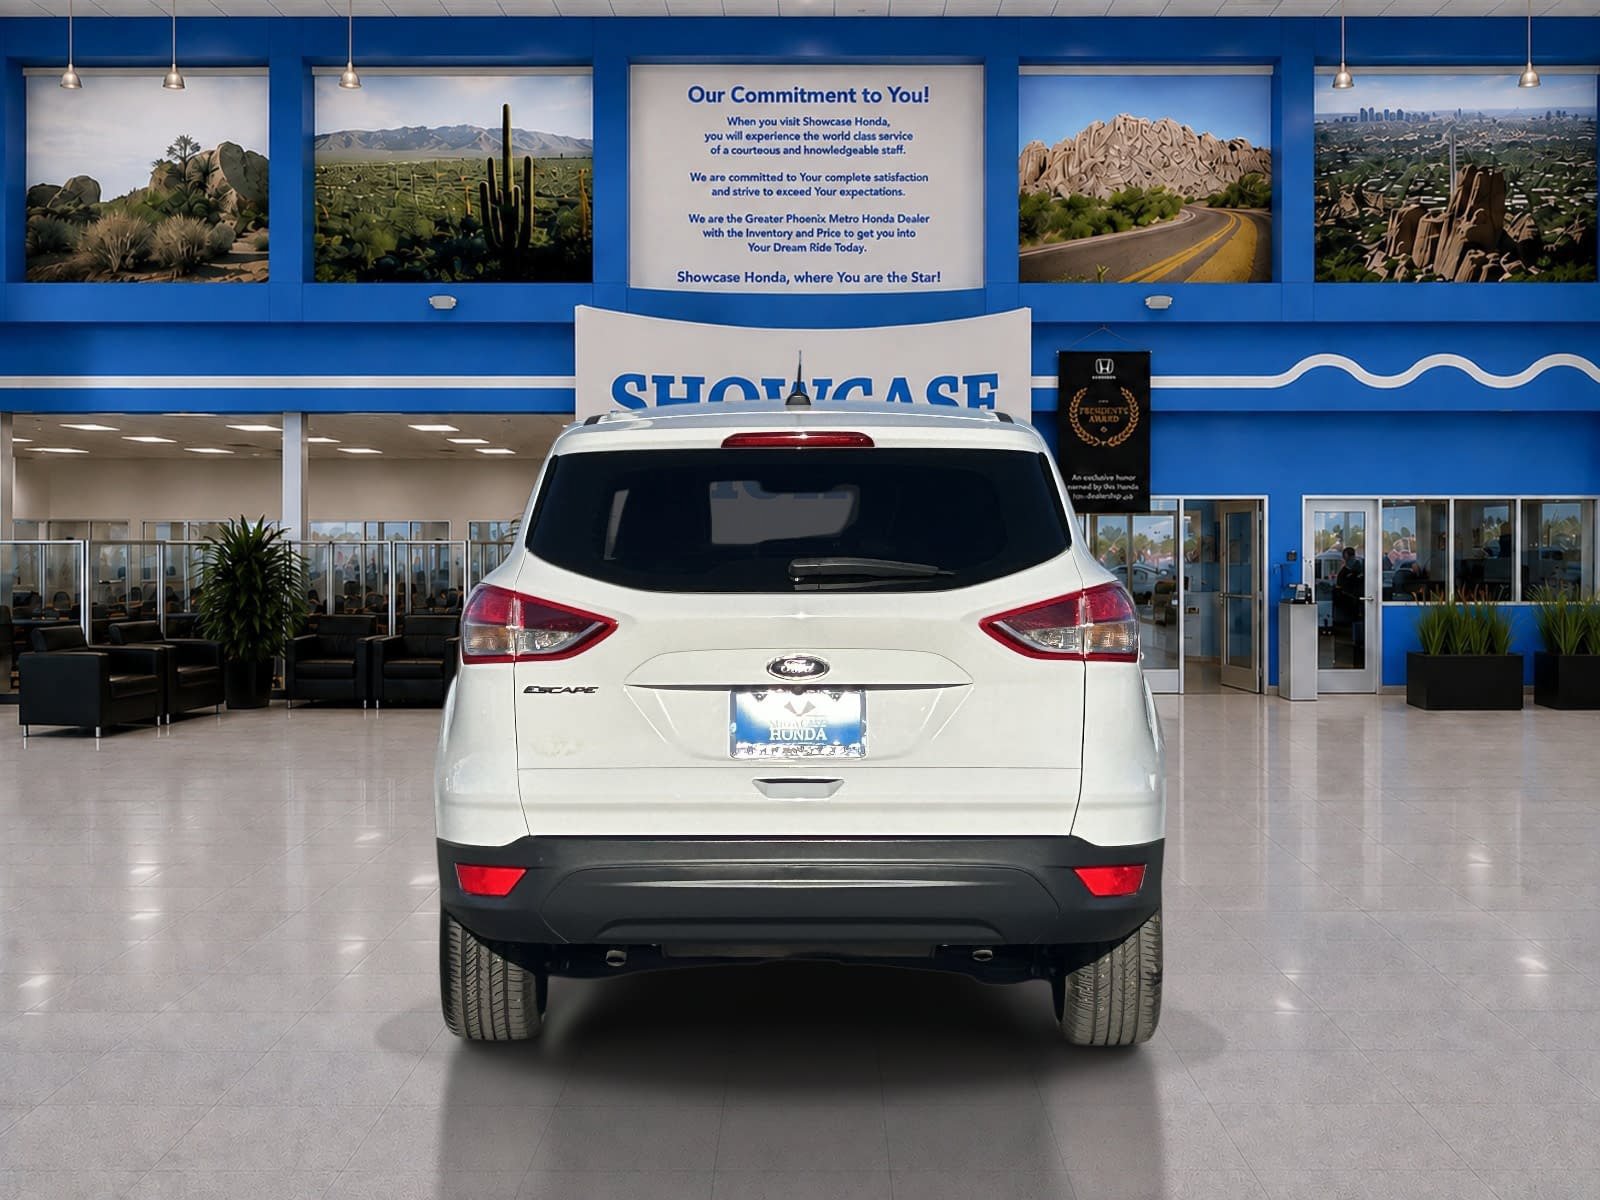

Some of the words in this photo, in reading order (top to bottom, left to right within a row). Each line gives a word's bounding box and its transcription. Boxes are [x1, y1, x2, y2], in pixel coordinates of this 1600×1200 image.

[688, 85, 726, 104] Our
[730, 86, 857, 104] Commitment
[861, 88, 883, 104] to
[886, 86, 929, 104] You!
[726, 116, 757, 126] When
[758, 119, 778, 129] you
[779, 116, 801, 127] visit
[802, 116, 852, 127] Showcase
[854, 116, 891, 128] Honda,
[704, 133, 724, 144] you
[725, 130, 743, 141] will
[745, 131, 801, 144] experience
[803, 130, 820, 141] the
[822, 130, 851, 141] world
[853, 131, 877, 141] class
[878, 131, 914, 141] service
[710, 144, 721, 155] of
[722, 147, 730, 155] a
[731, 146, 781, 155] courteous
[782, 144, 802, 155] and
[690, 172, 708, 182] We
[728, 172, 784, 182] committed
[786, 173, 798, 182] to
[799, 172, 823, 182] Your
[824, 172, 872, 185] complete
[873, 172, 929, 182] satisfaction
[711, 186, 731, 196] and
[732, 186, 761, 197] strive
[762, 188, 774, 197] to
[776, 186, 812, 197] exceed
[814, 186, 838, 197] Your
[839, 186, 906, 200] expectations.
[688, 214, 706, 224] We
[708, 216, 725, 224] are
[726, 214, 743, 224] the
[744, 214, 784, 224] Greater
[786, 214, 827, 224] Phoenix
[829, 214, 860, 224] Metro
[862, 214, 895, 224] Honda
[897, 214, 930, 224] Dealer
[702, 227, 725, 238] with
[726, 227, 744, 238] the
[746, 228, 794, 241] Inventory
[795, 228, 814, 238] and
[816, 228, 842, 238] Price
[844, 229, 855, 238] to
[856, 229, 874, 241] get
[876, 230, 895, 241] you
[896, 228, 916, 238] into
[747, 242, 772, 253] Your
[773, 242, 807, 253] Dream
[809, 242, 833, 252] Ride
[834, 242, 867, 255] Today.
[677, 270, 741, 283] Showcase
[744, 271, 790, 286] Honda,
[794, 271, 834, 284] where
[836, 271, 860, 283] You
[864, 274, 884, 284] are
[886, 271, 908, 284] the
[911, 271, 941, 284] Star!
[1093, 483, 1102, 492] by
[523, 685, 600, 694] ESCAPE
